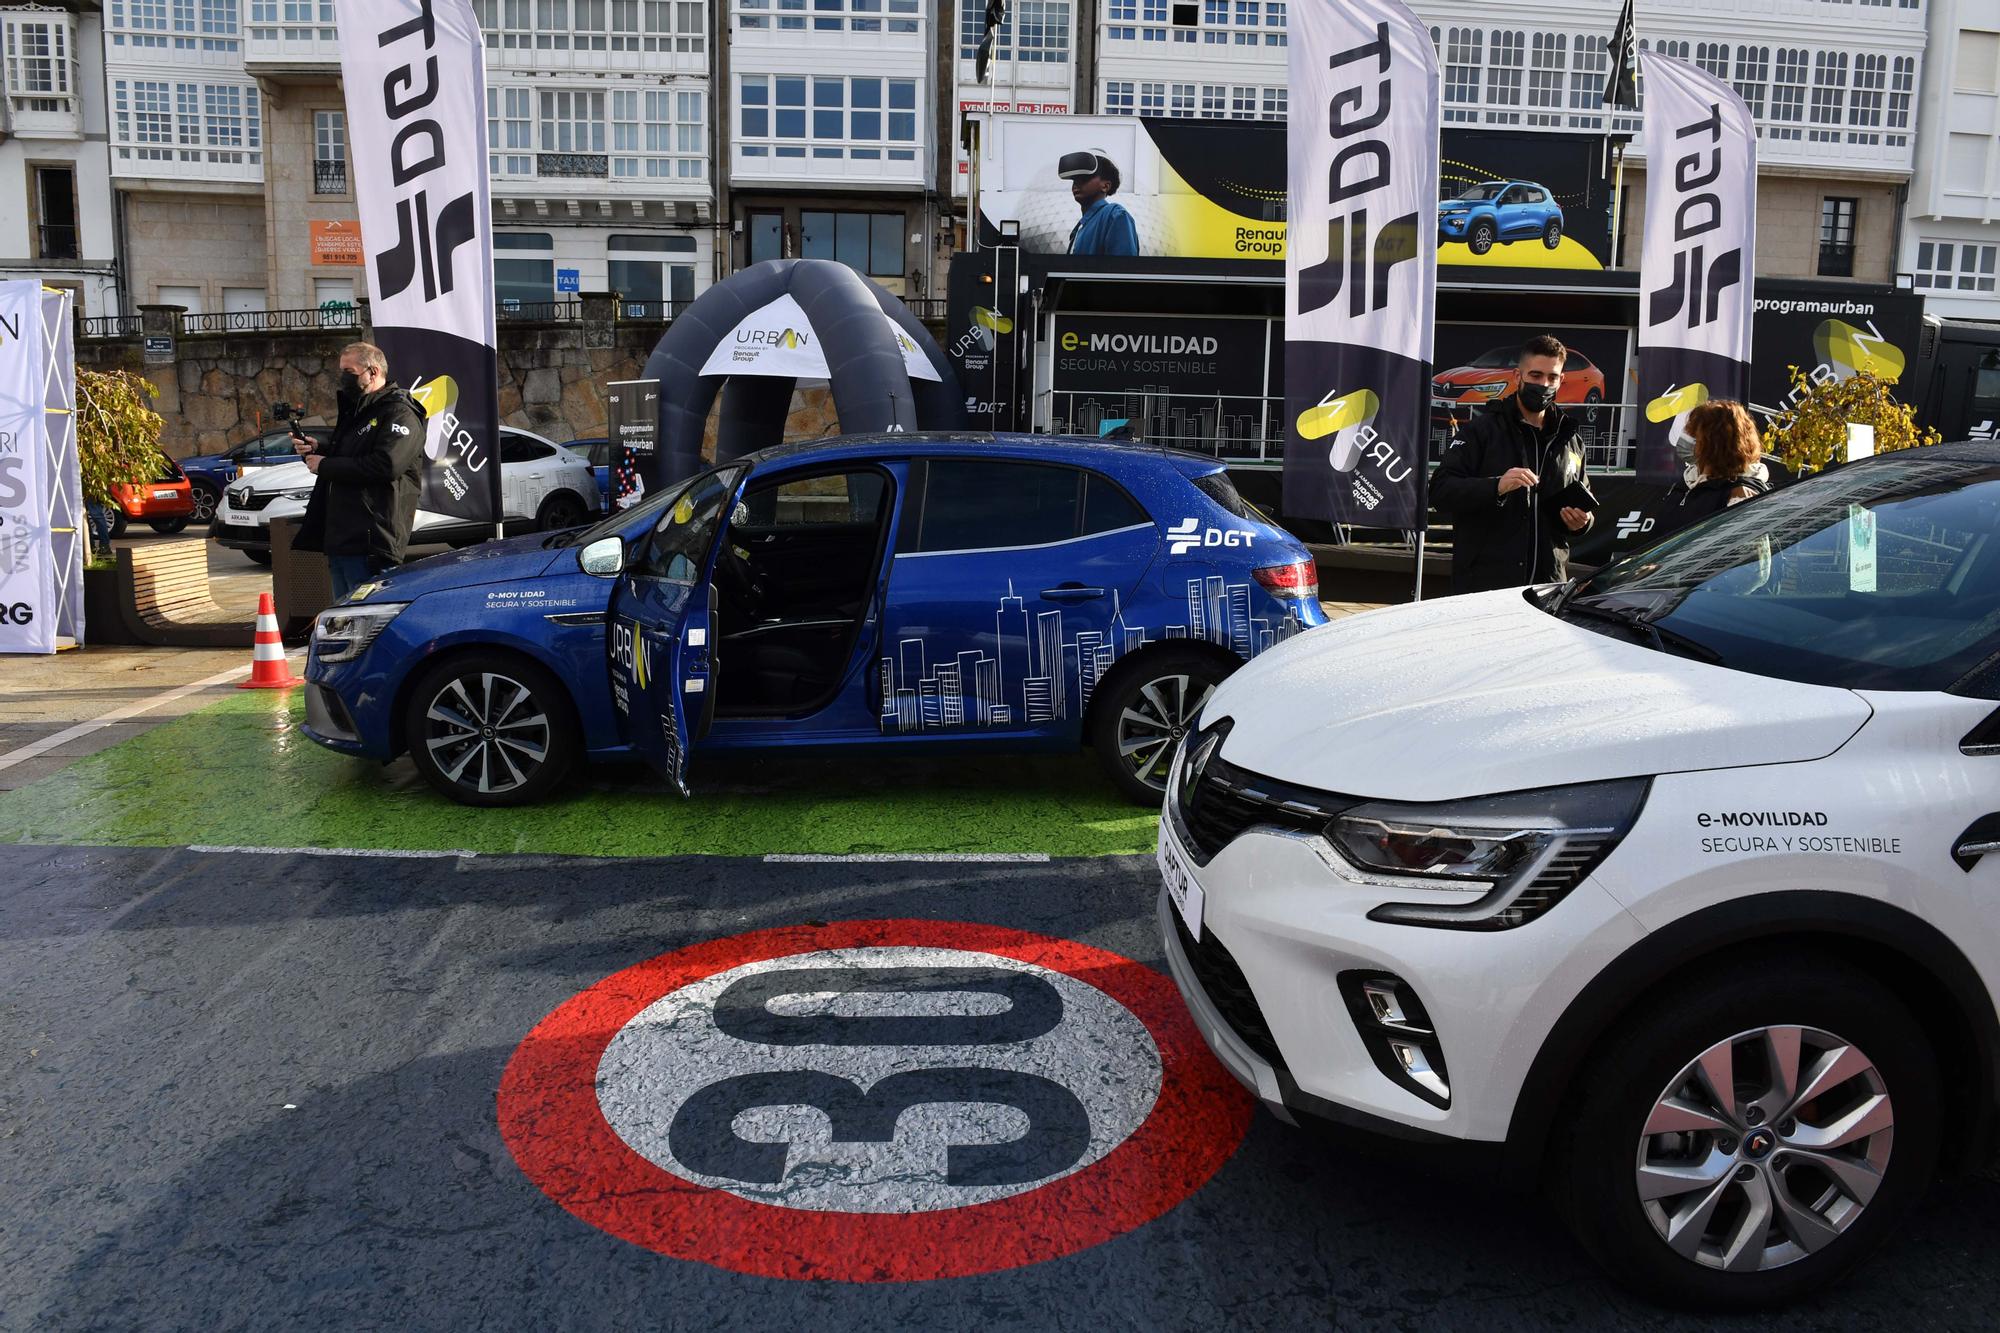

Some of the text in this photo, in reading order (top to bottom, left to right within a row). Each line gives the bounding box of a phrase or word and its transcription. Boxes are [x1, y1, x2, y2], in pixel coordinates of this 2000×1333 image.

[965, 103, 1010, 112] VENDIDO
[1019, 105, 1032, 113] EN
[1033, 104, 1041, 113] 3
[1235, 227, 1287, 241] Renaul
[1235, 241, 1283, 255] Group
[558, 276, 579, 285] TAXI
[1061, 332, 1218, 355] e-MOVILIDAD
[1060, 358, 1217, 374] SEGURA Y SOSTENIBLE
[1203, 527, 1256, 548] DGT
[485, 599, 577, 609] SEGURA Y SOSTENIBLE
[1697, 812, 1828, 827] e-MOVILIDAD
[1701, 836, 1902, 854] SEGURA Y SOSTENIBLE
[1164, 841, 1188, 900] CAPTUR
[668, 967, 1091, 1187] 30
